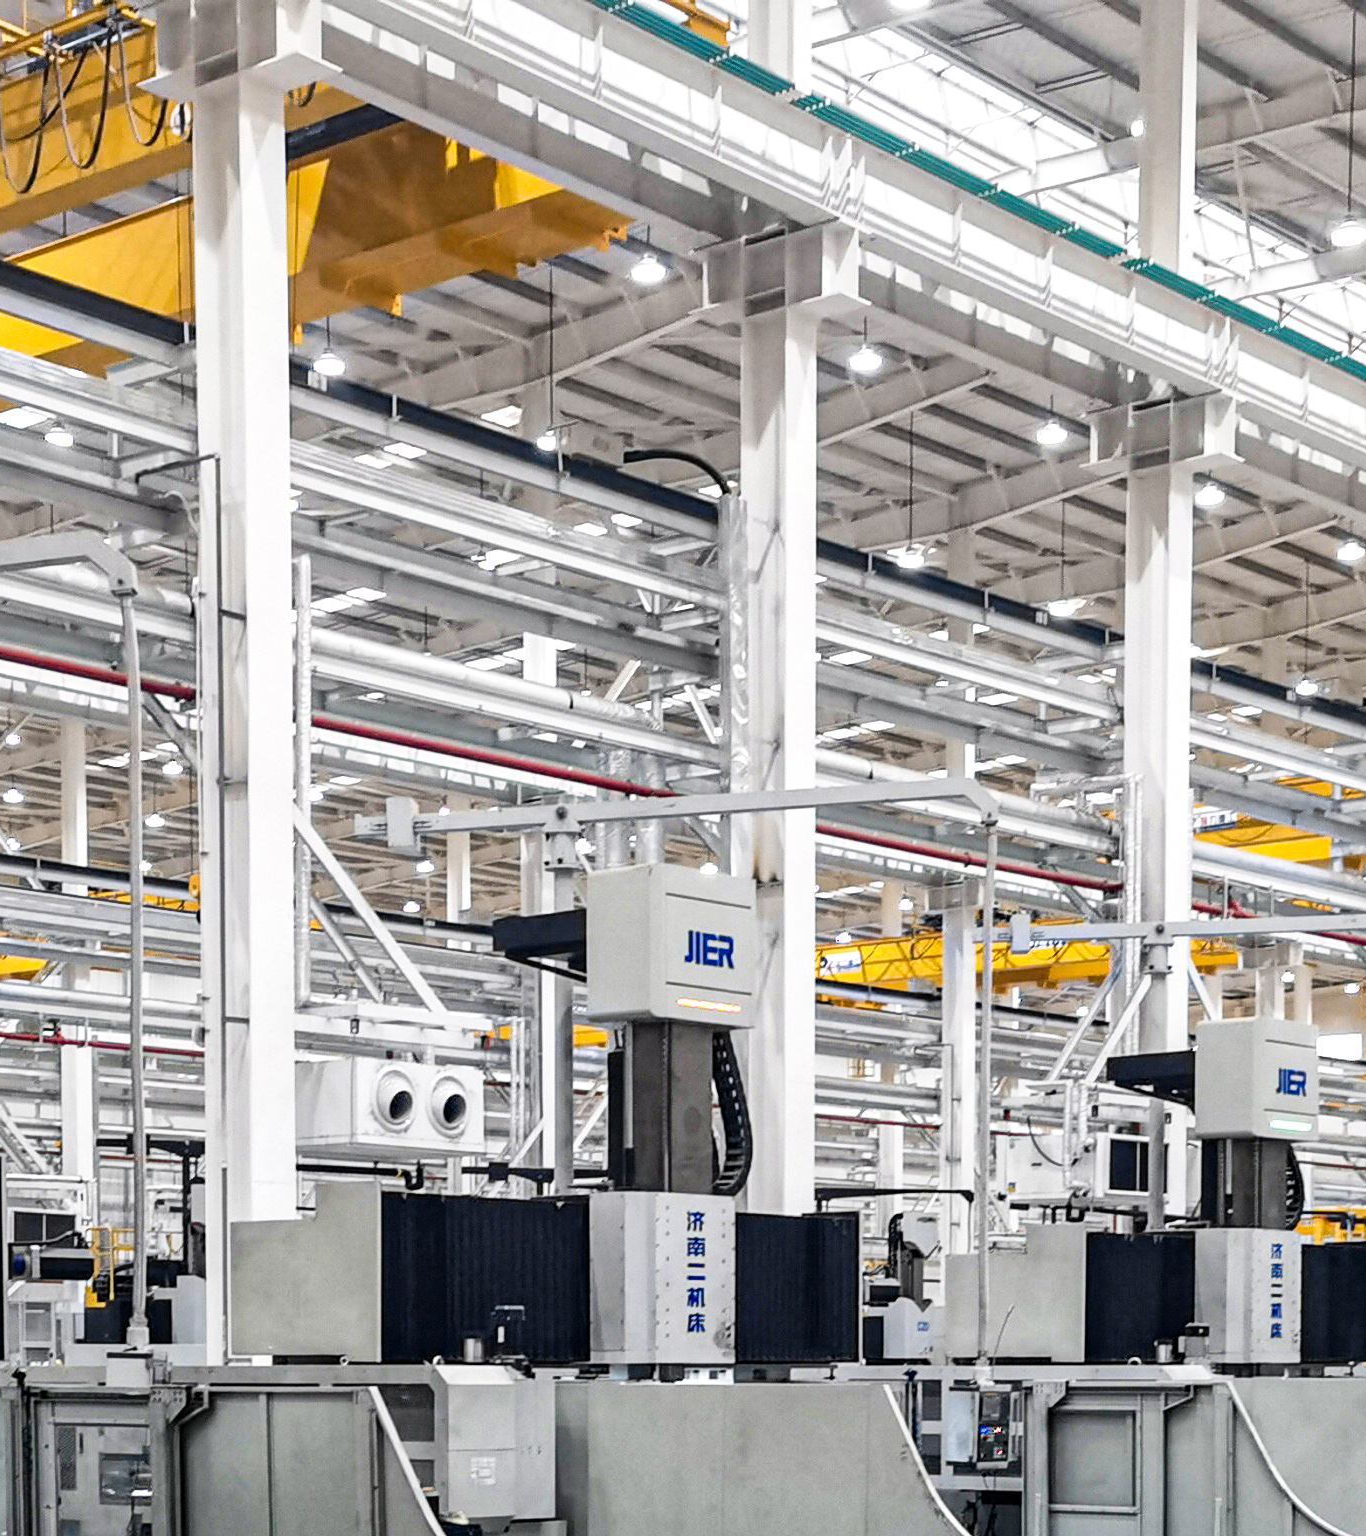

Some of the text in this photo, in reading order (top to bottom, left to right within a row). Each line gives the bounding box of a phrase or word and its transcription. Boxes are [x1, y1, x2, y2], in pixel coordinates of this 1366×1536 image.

[684, 930, 735, 969] JIER
[1276, 1068, 1307, 1097] JIER
[686, 1211, 706, 1333] 济南二机床
